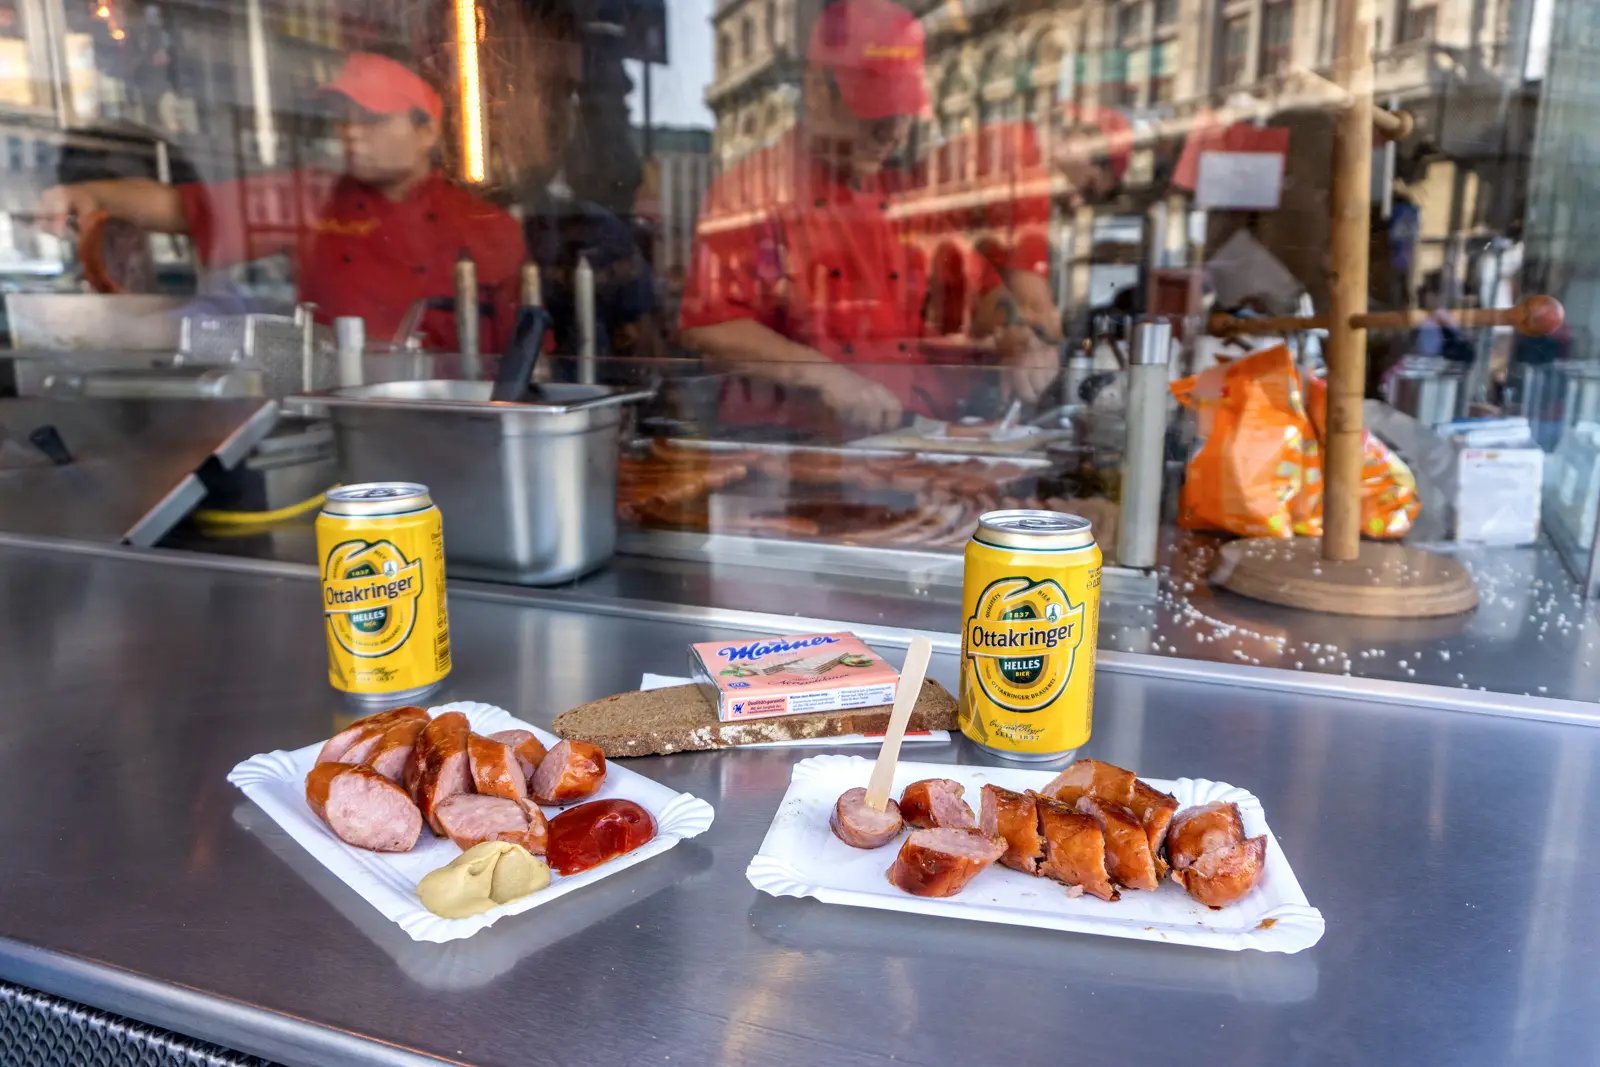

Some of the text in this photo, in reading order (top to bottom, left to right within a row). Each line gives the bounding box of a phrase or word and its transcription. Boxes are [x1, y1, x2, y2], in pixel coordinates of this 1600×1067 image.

[325, 575, 414, 606] Ottakringer
[352, 609, 386, 622] HELLES
[1008, 611, 1030, 619] 1837
[972, 622, 1076, 649] Ottakringer
[717, 635, 841, 662] Manner
[1003, 659, 1041, 671] HELLES
[991, 680, 1031, 701] OTTAKRINGER
